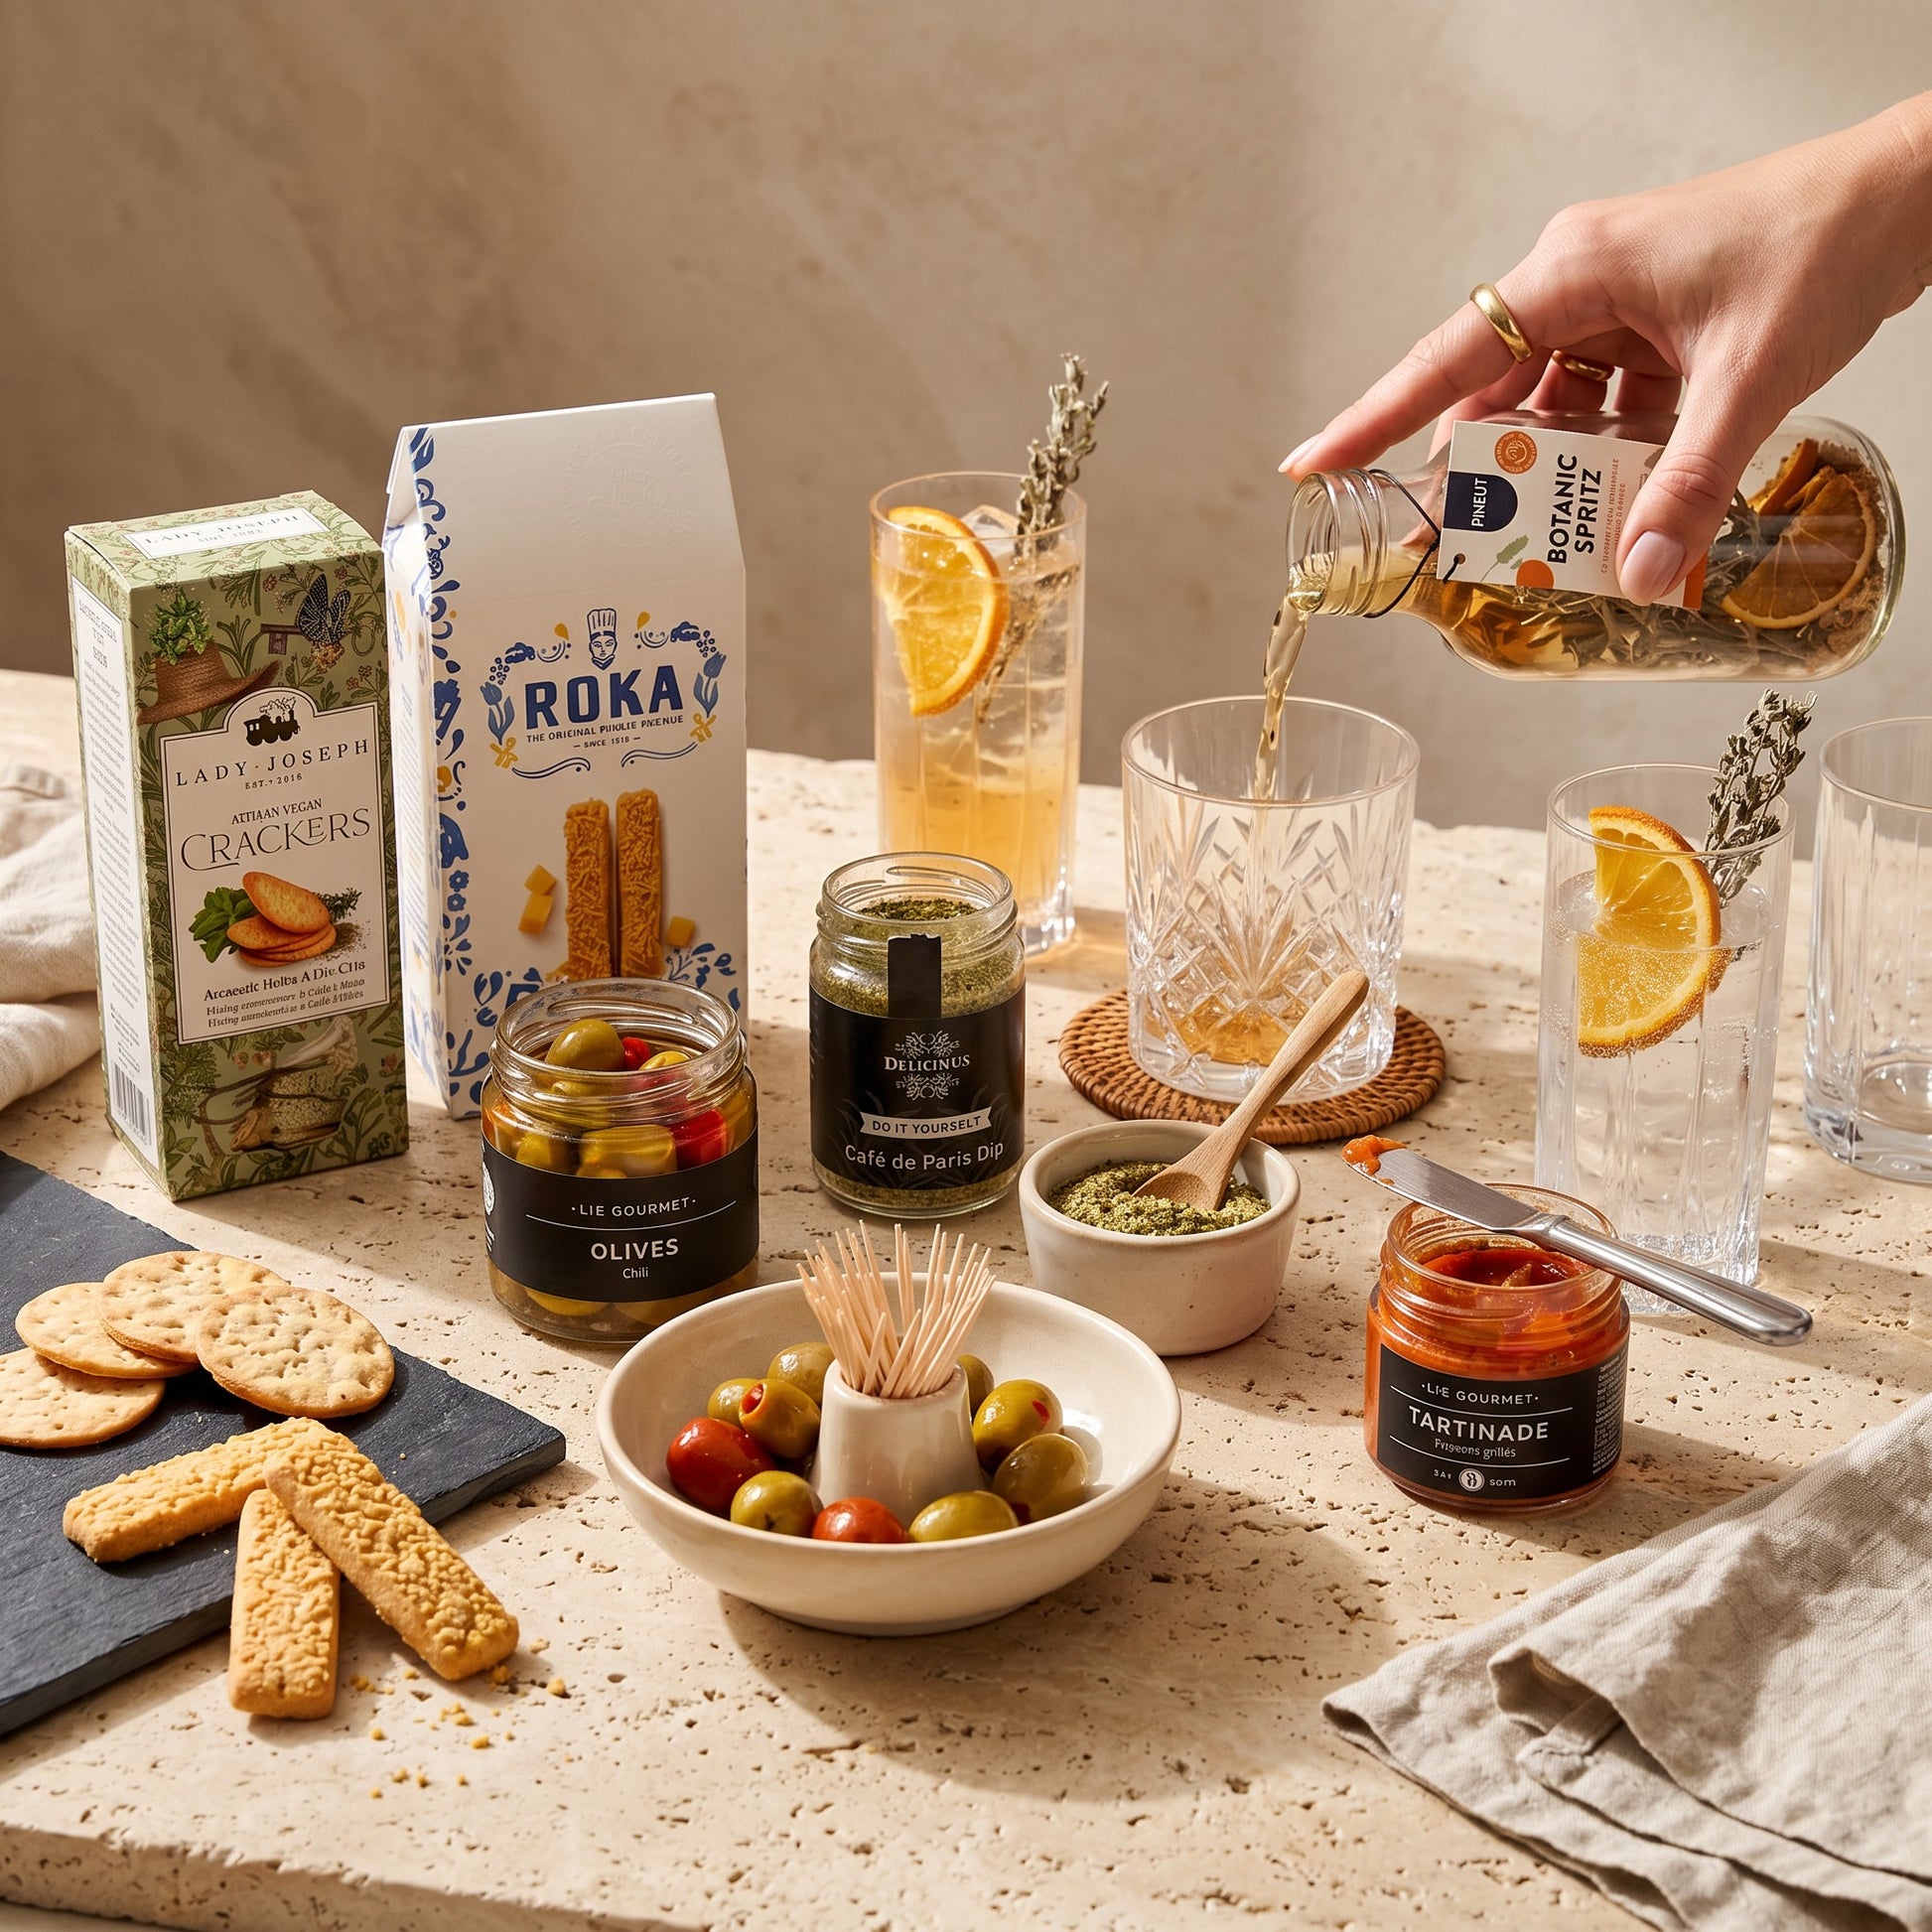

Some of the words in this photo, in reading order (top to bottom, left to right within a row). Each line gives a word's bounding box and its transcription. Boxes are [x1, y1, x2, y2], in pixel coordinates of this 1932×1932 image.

[1470, 477, 1488, 527] PINEUT
[1547, 453, 1578, 564] BOTANIC
[1574, 468, 1602, 554] SPRITZ
[524, 664, 684, 730] ROKA
[526, 733, 546, 744] THE
[175, 760, 248, 787] LADY
[267, 739, 369, 771] JOSEPH
[282, 798, 324, 817] VEGAN
[180, 807, 371, 872] CRACKERS
[872, 1120, 892, 1133] DO
[895, 1123, 908, 1134] IT
[845, 1144, 887, 1169] Café
[892, 1153, 916, 1171] de
[922, 1150, 972, 1171] Paris
[977, 1142, 1004, 1162] Dip
[580, 1203, 606, 1217] LIE
[612, 1196, 691, 1217] GOURMET
[590, 1238, 679, 1261] OLIVES
[622, 1266, 649, 1280] Chili
[1455, 1390, 1534, 1405] GOURMET
[1408, 1405, 1549, 1443] TARTINADE
[1489, 1477, 1517, 1487] som
